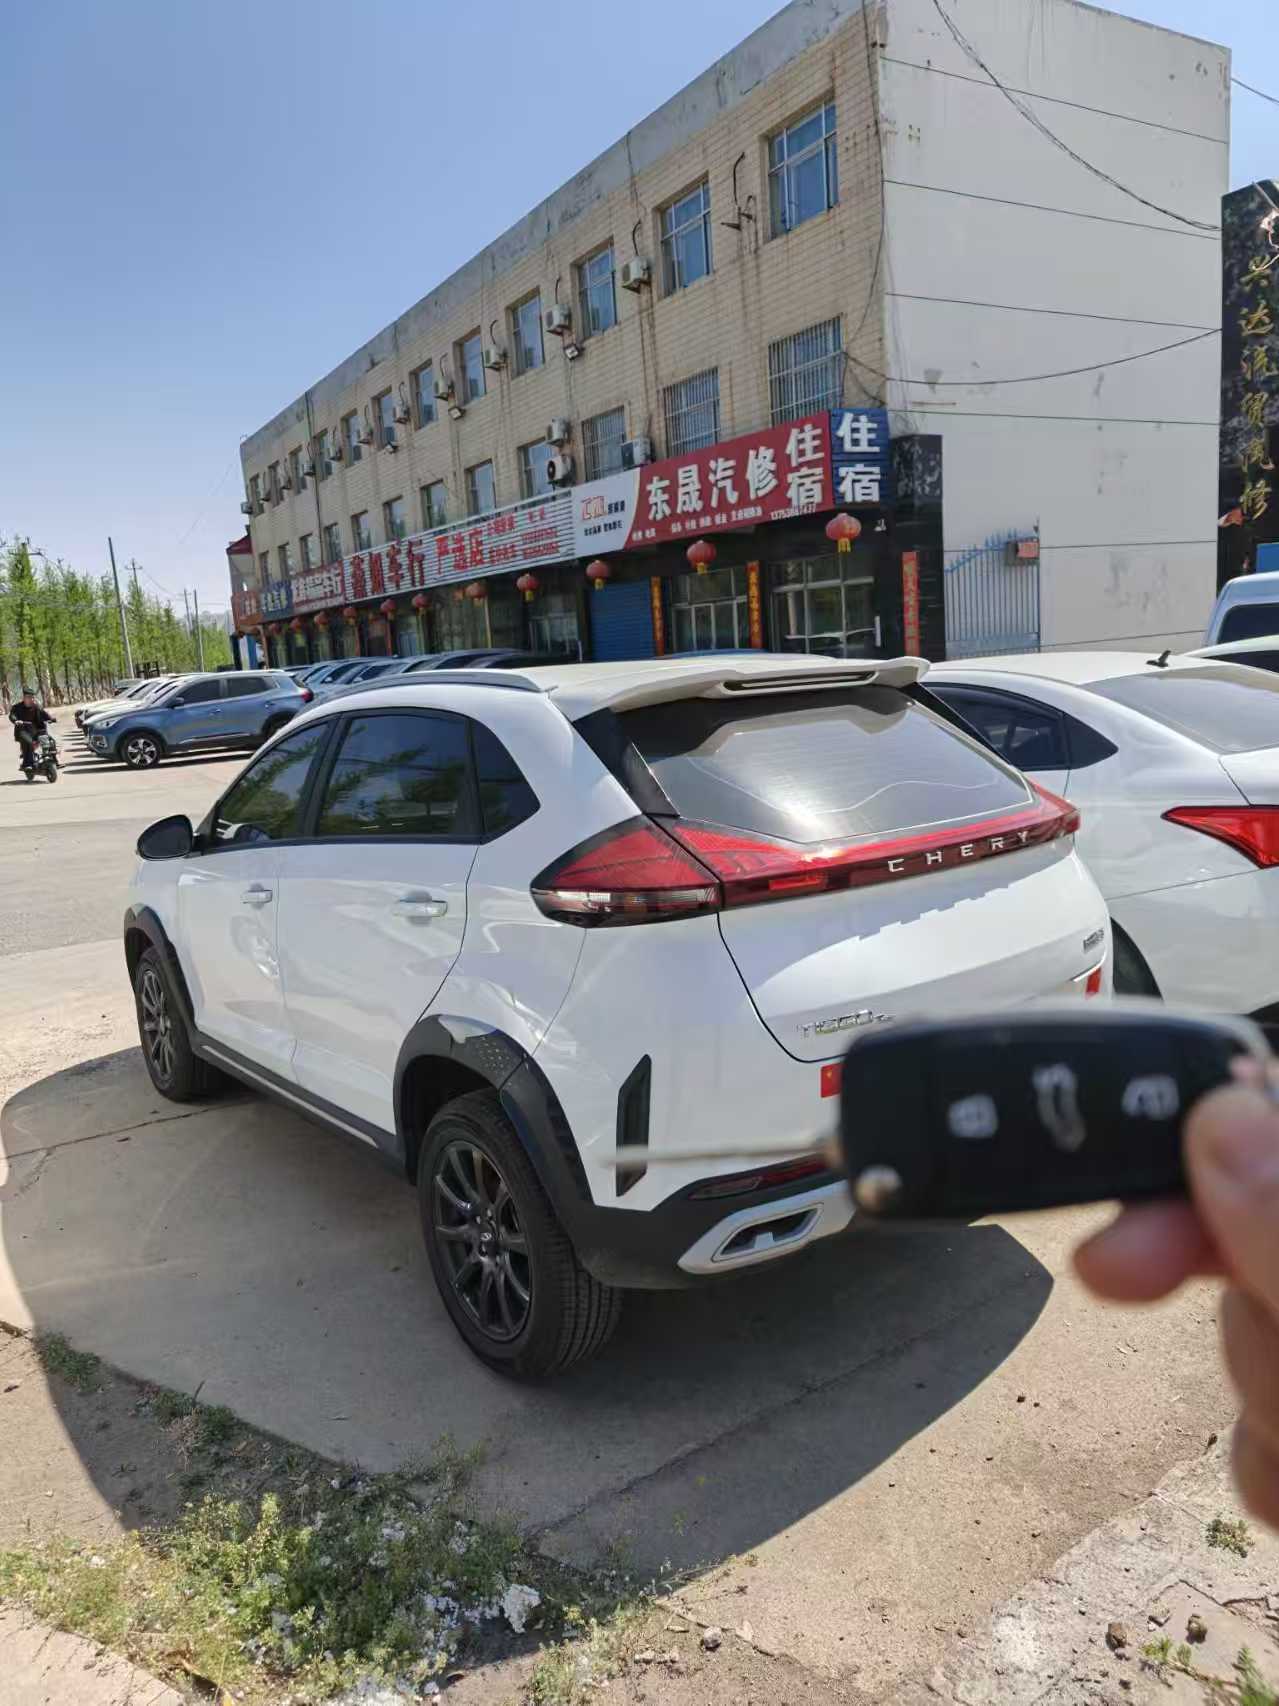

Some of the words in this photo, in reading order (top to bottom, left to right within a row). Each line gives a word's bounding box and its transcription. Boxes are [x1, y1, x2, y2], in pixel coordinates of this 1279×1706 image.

[647, 446, 779, 521] 东晟汽修
[785, 423, 825, 506] 住宿
[836, 412, 881, 503] 住宿
[888, 830, 1030, 873] CHERY
